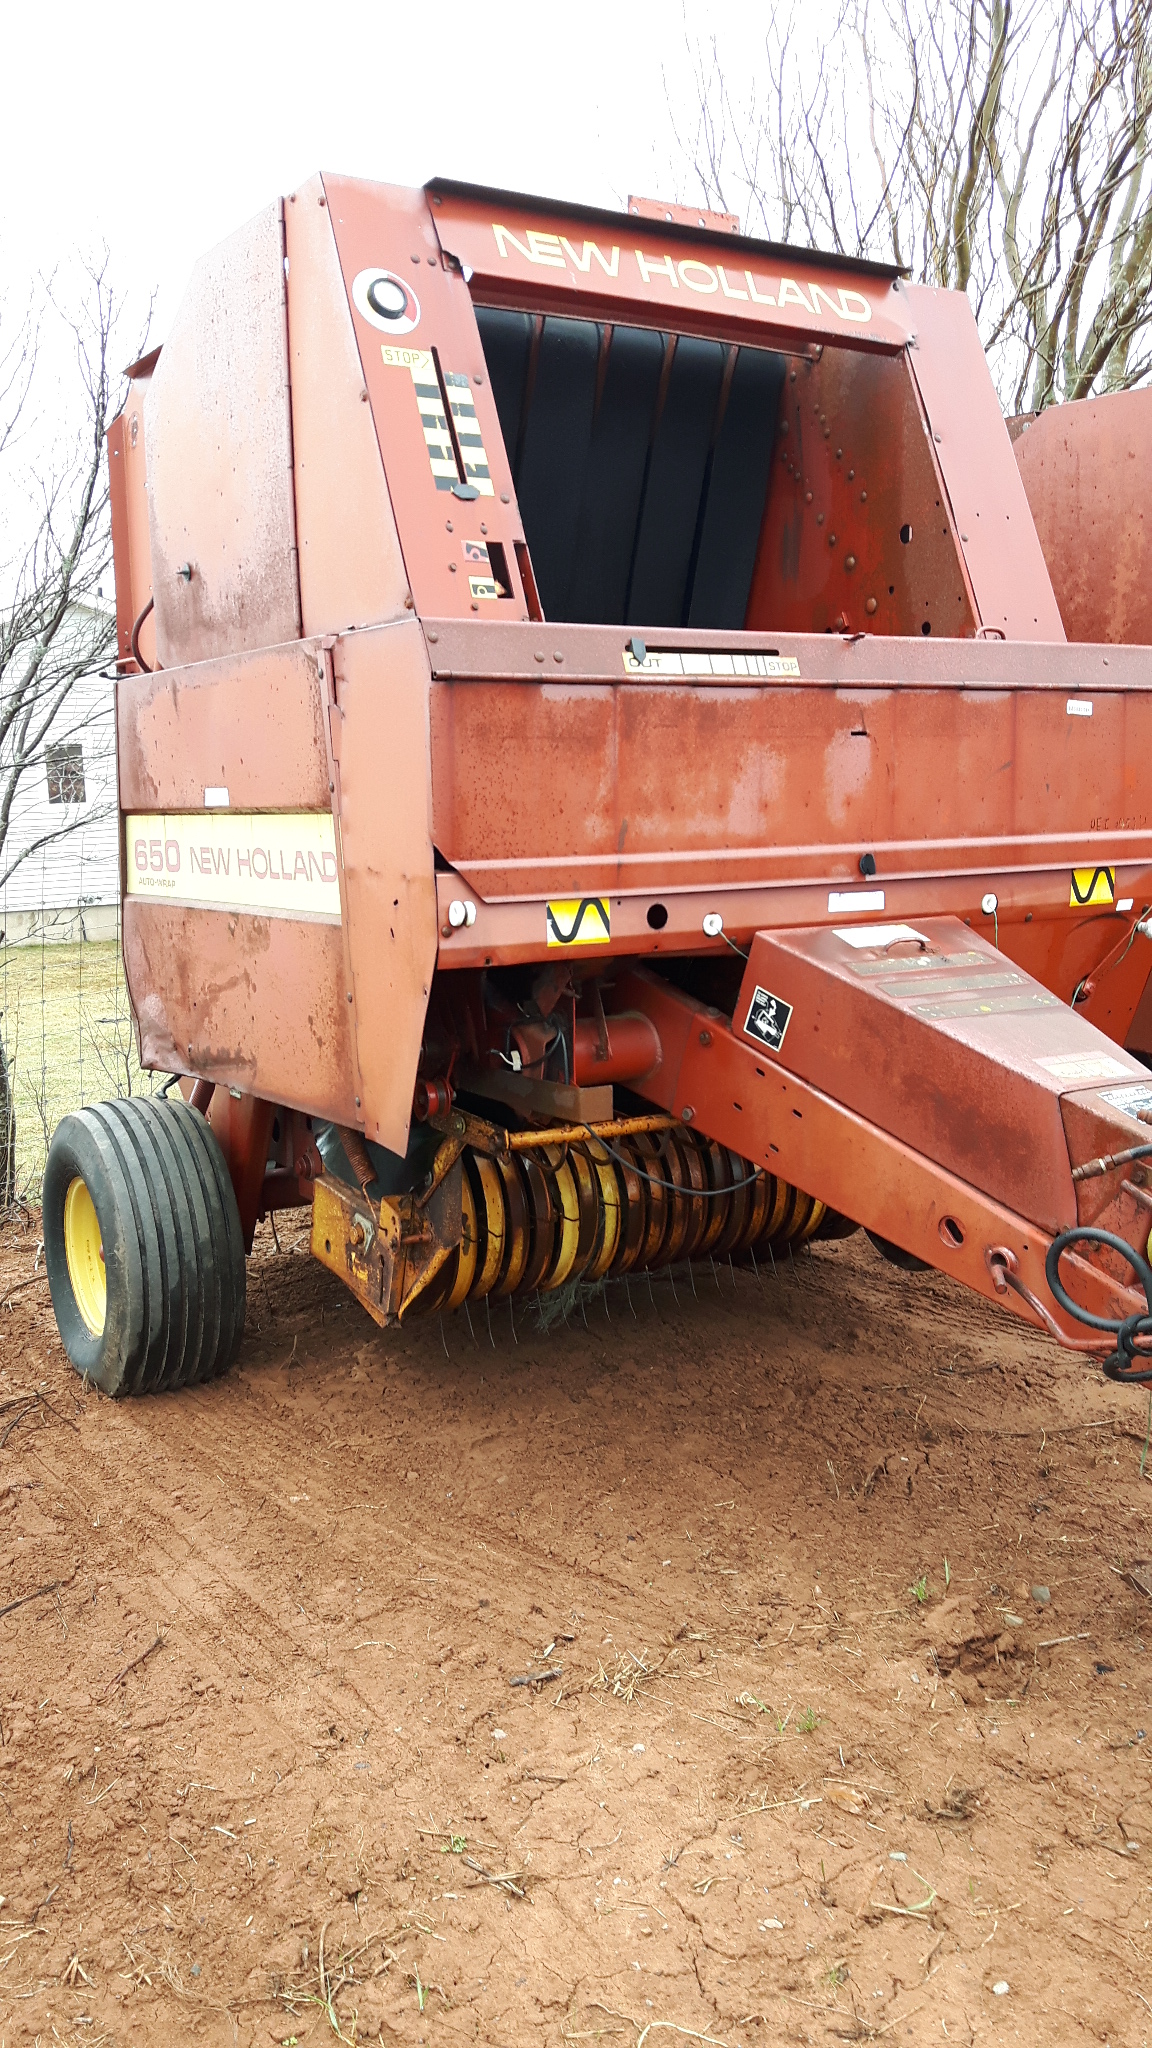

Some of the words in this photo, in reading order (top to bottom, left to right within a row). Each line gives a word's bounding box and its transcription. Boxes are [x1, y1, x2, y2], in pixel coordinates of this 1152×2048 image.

[492, 223, 620, 278] NEW
[634, 249, 873, 323] HOLLAND
[384, 349, 420, 364] STOP
[628, 657, 662, 668] OUT
[768, 661, 798, 671] STOP
[134, 838, 181, 873] 650
[190, 846, 231, 876] NEW
[236, 847, 339, 883] HOLLAND
[138, 876, 176, 889] AUTO-WRAP
